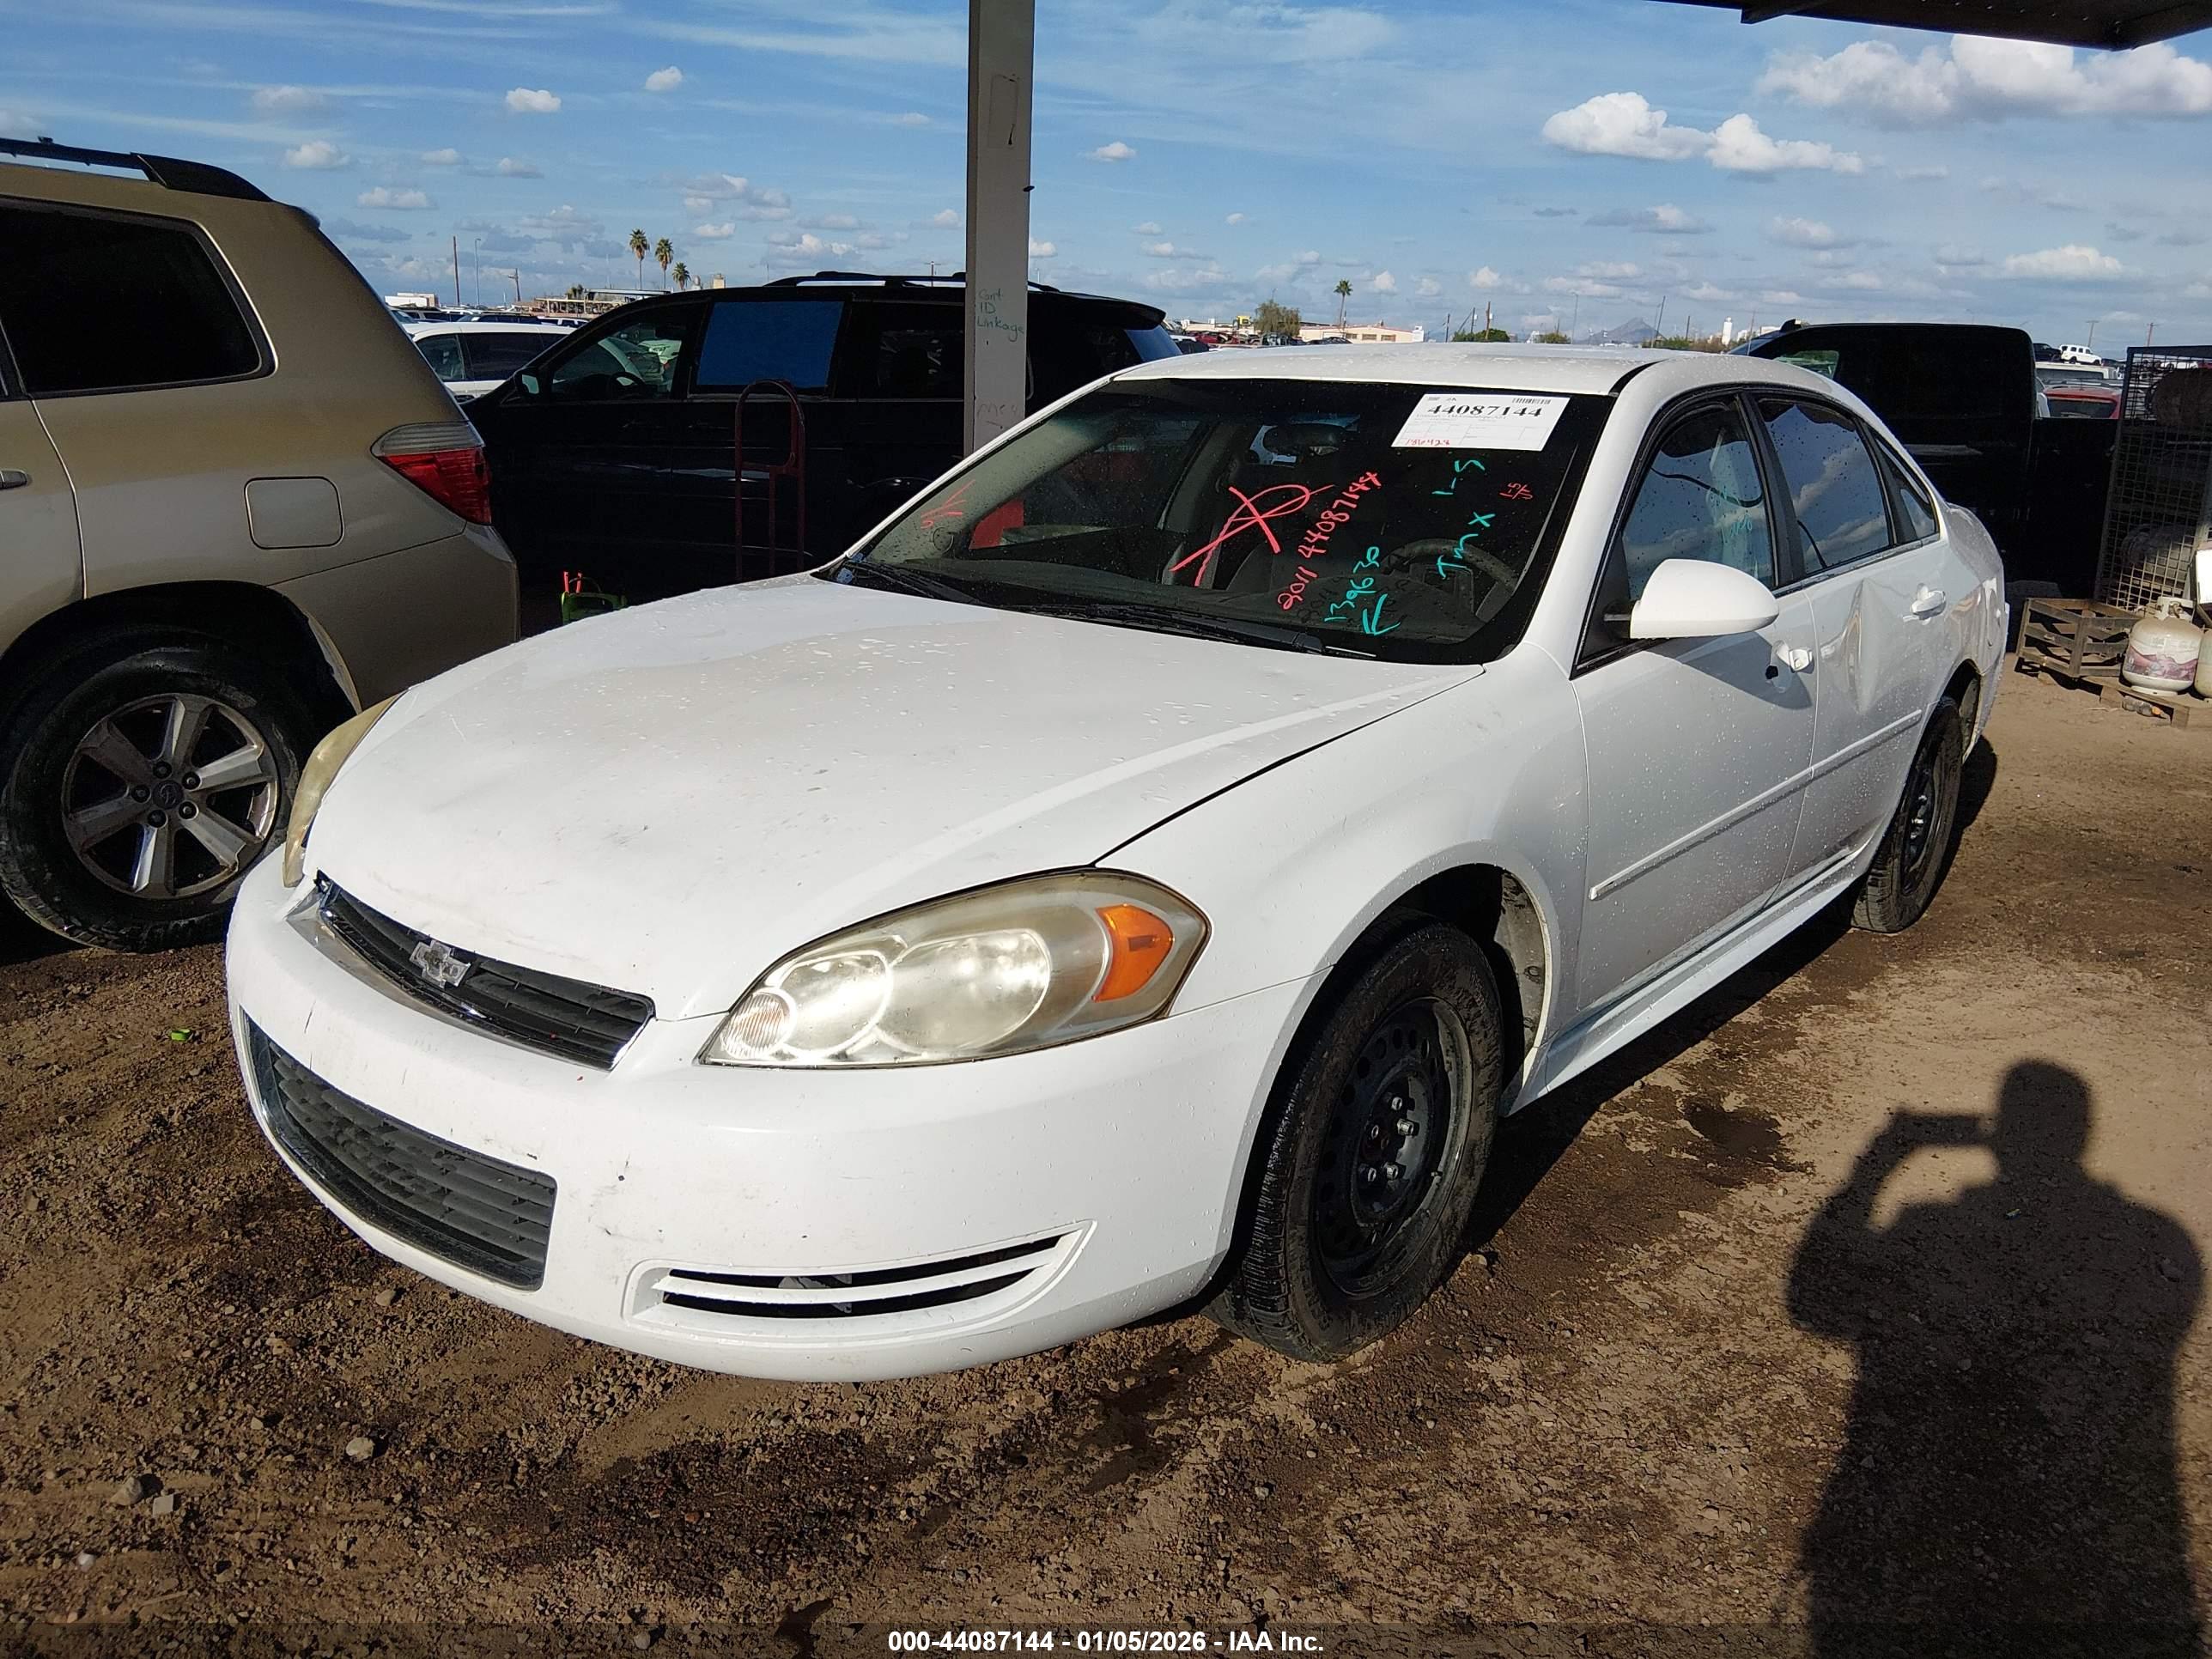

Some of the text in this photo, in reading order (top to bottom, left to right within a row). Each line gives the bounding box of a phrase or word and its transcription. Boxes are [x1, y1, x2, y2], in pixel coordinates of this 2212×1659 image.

[1428, 404, 1542, 417] 44087144
[1277, 471, 1382, 611] 2011 44087144
[1323, 545, 1381, 623] 139630
